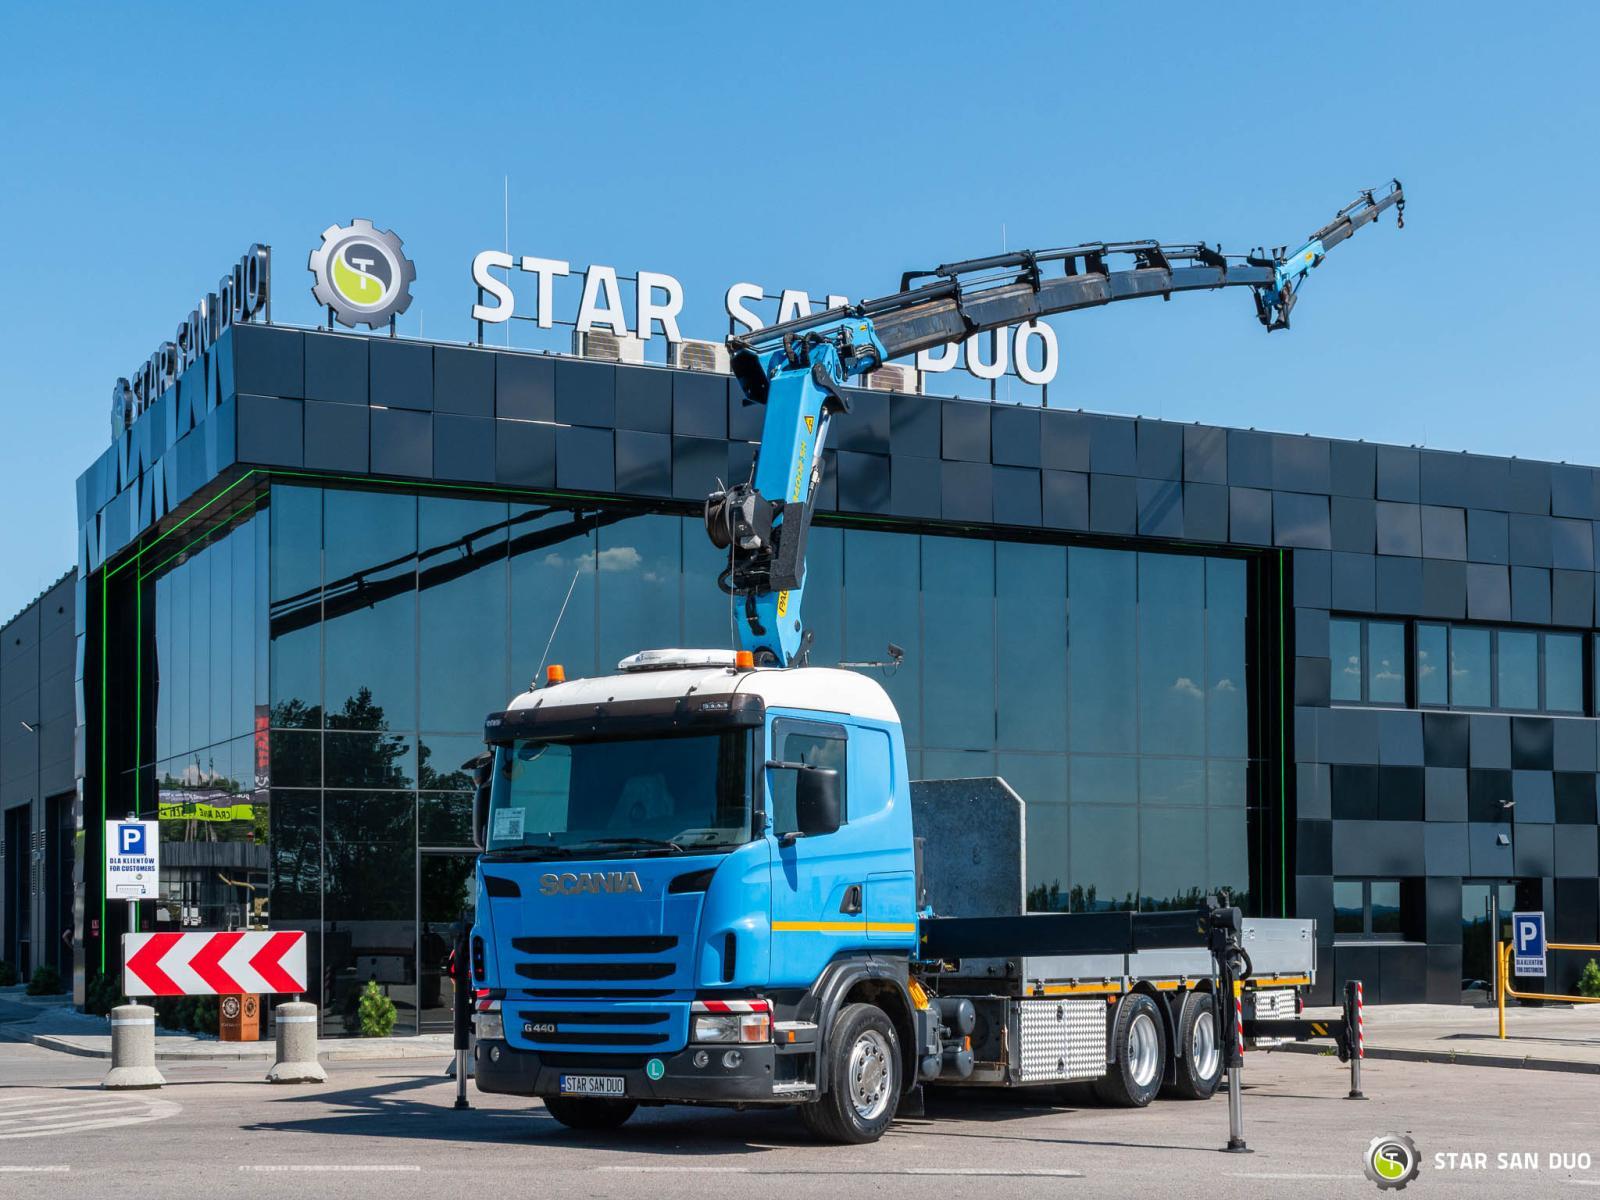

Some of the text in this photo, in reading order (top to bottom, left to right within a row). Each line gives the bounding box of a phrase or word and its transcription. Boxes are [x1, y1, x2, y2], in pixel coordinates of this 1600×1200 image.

[472, 250, 684, 343] STAR
[131, 243, 267, 422] STAR SAN DUO
[123, 828, 141, 851] P
[539, 871, 643, 897] SCANIA
[1520, 921, 1537, 951] P
[651, 1062, 660, 1077] L
[566, 1077, 624, 1093] STAR SAN DUO
